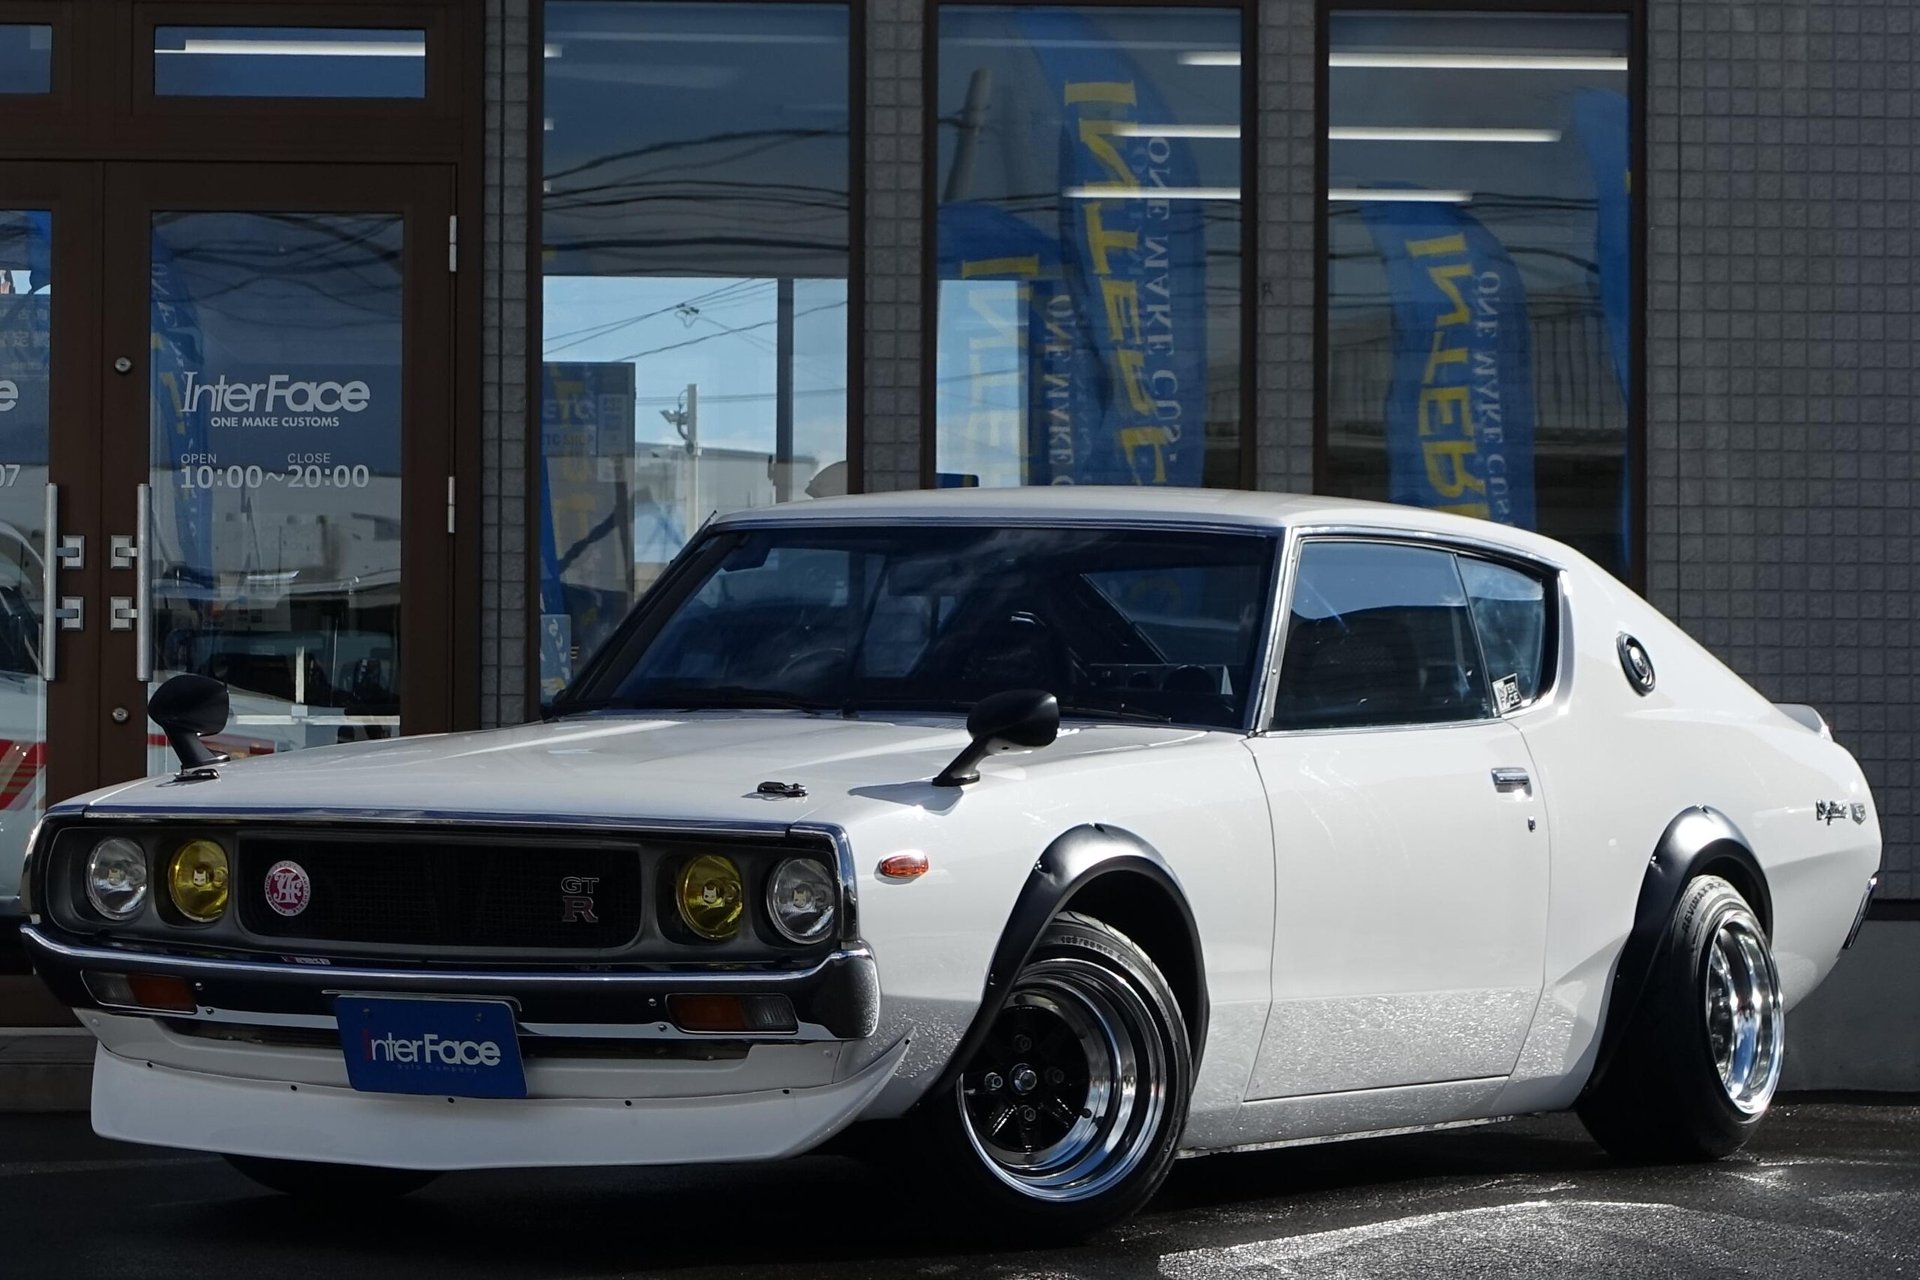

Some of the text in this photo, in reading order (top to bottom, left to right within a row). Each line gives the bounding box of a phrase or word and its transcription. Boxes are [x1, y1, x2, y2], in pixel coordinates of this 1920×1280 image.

[179, 370, 371, 413] InterFace
[210, 417, 340, 427] ONE MAKE CUSTOMS
[180, 453, 331, 464] OPEN CLOSE
[561, 876, 600, 894] GT
[562, 895, 599, 923] R
[362, 1026, 502, 1067] InterFace
